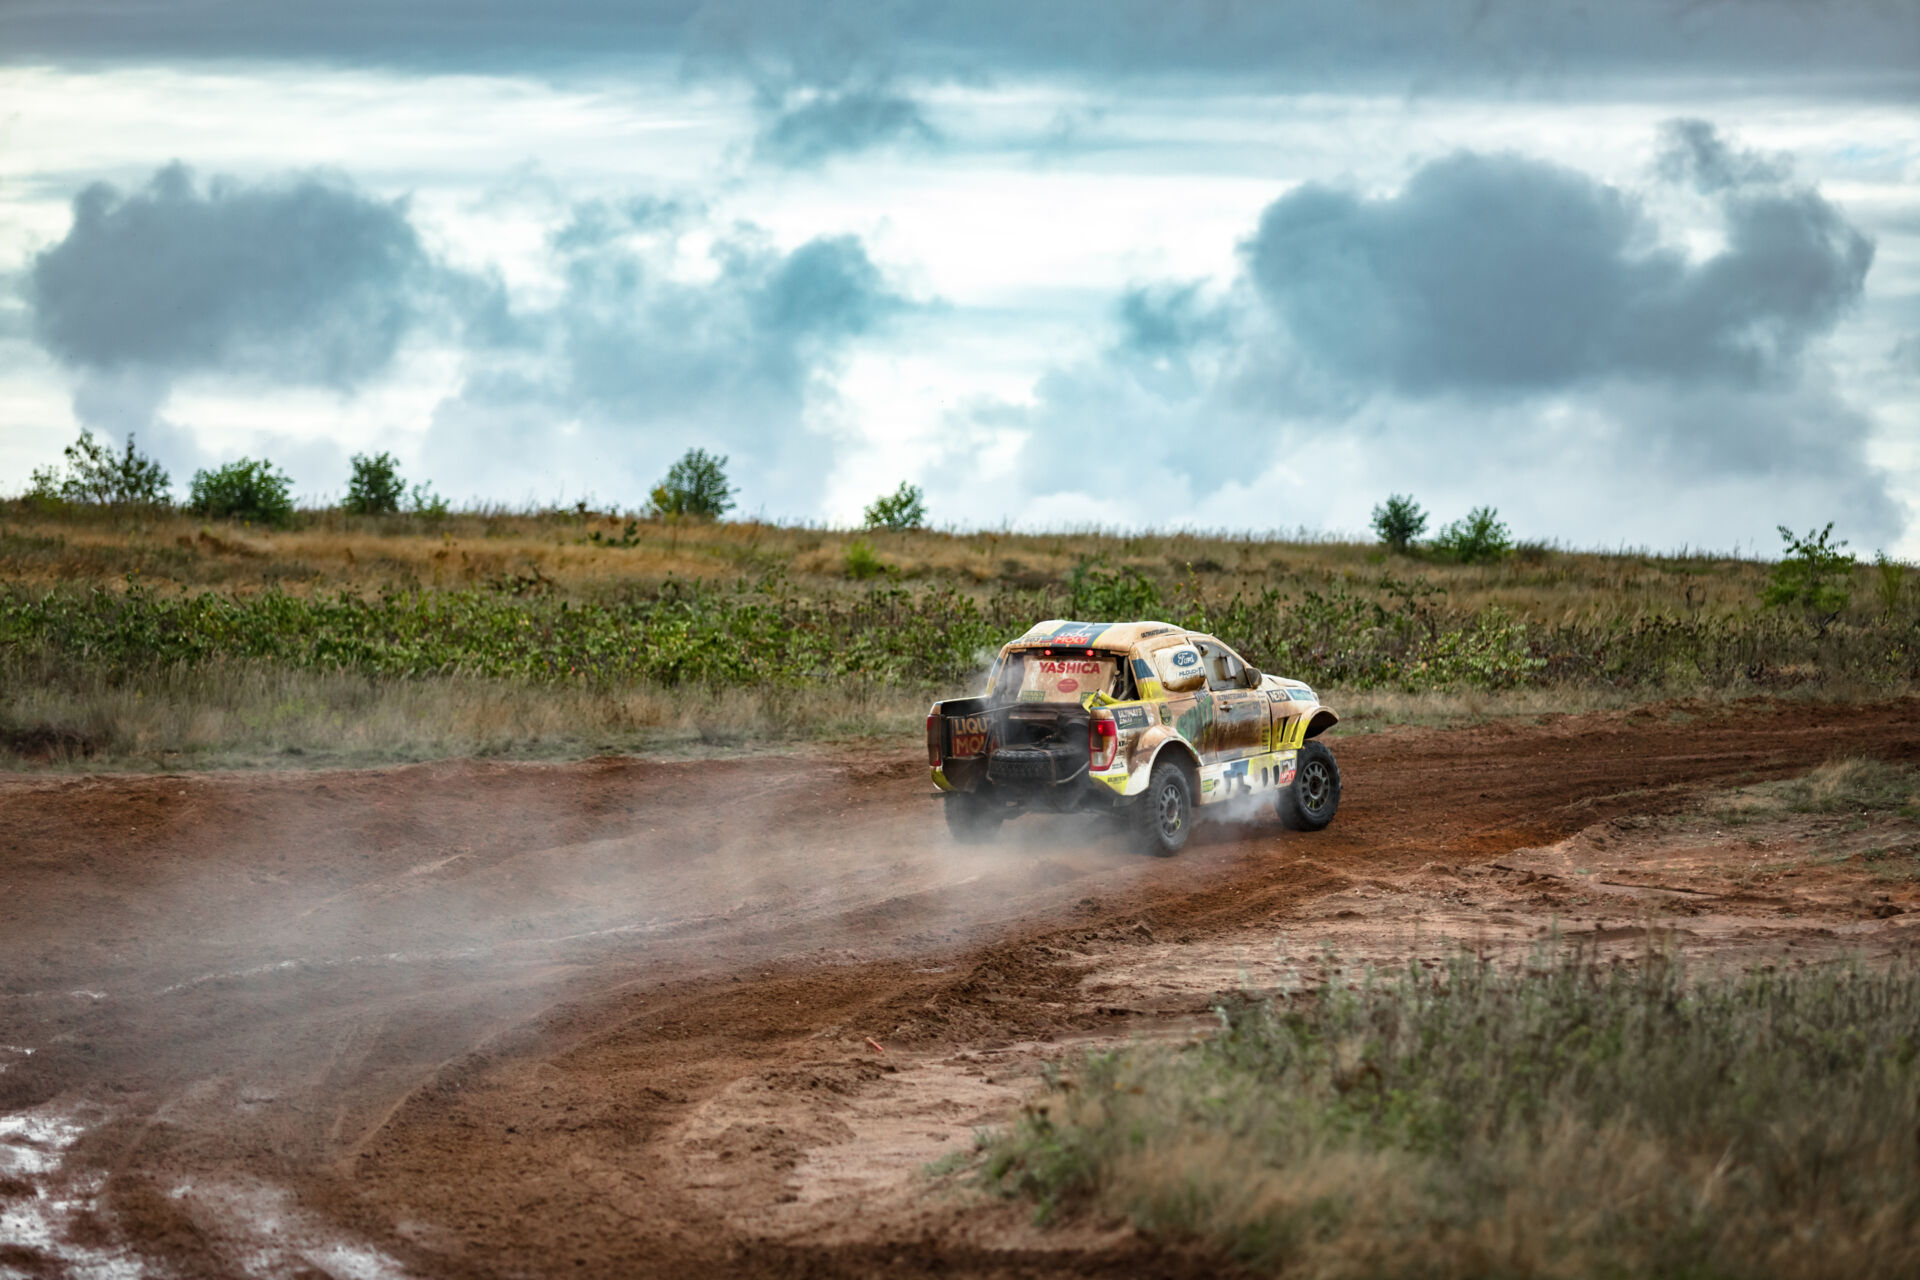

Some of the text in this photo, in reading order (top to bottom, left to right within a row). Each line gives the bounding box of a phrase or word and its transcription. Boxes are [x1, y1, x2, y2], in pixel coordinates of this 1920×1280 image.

[1055, 636, 1088, 644] MOLY
[1177, 652, 1195, 666] Ford
[1039, 662, 1100, 674] YASHICA
